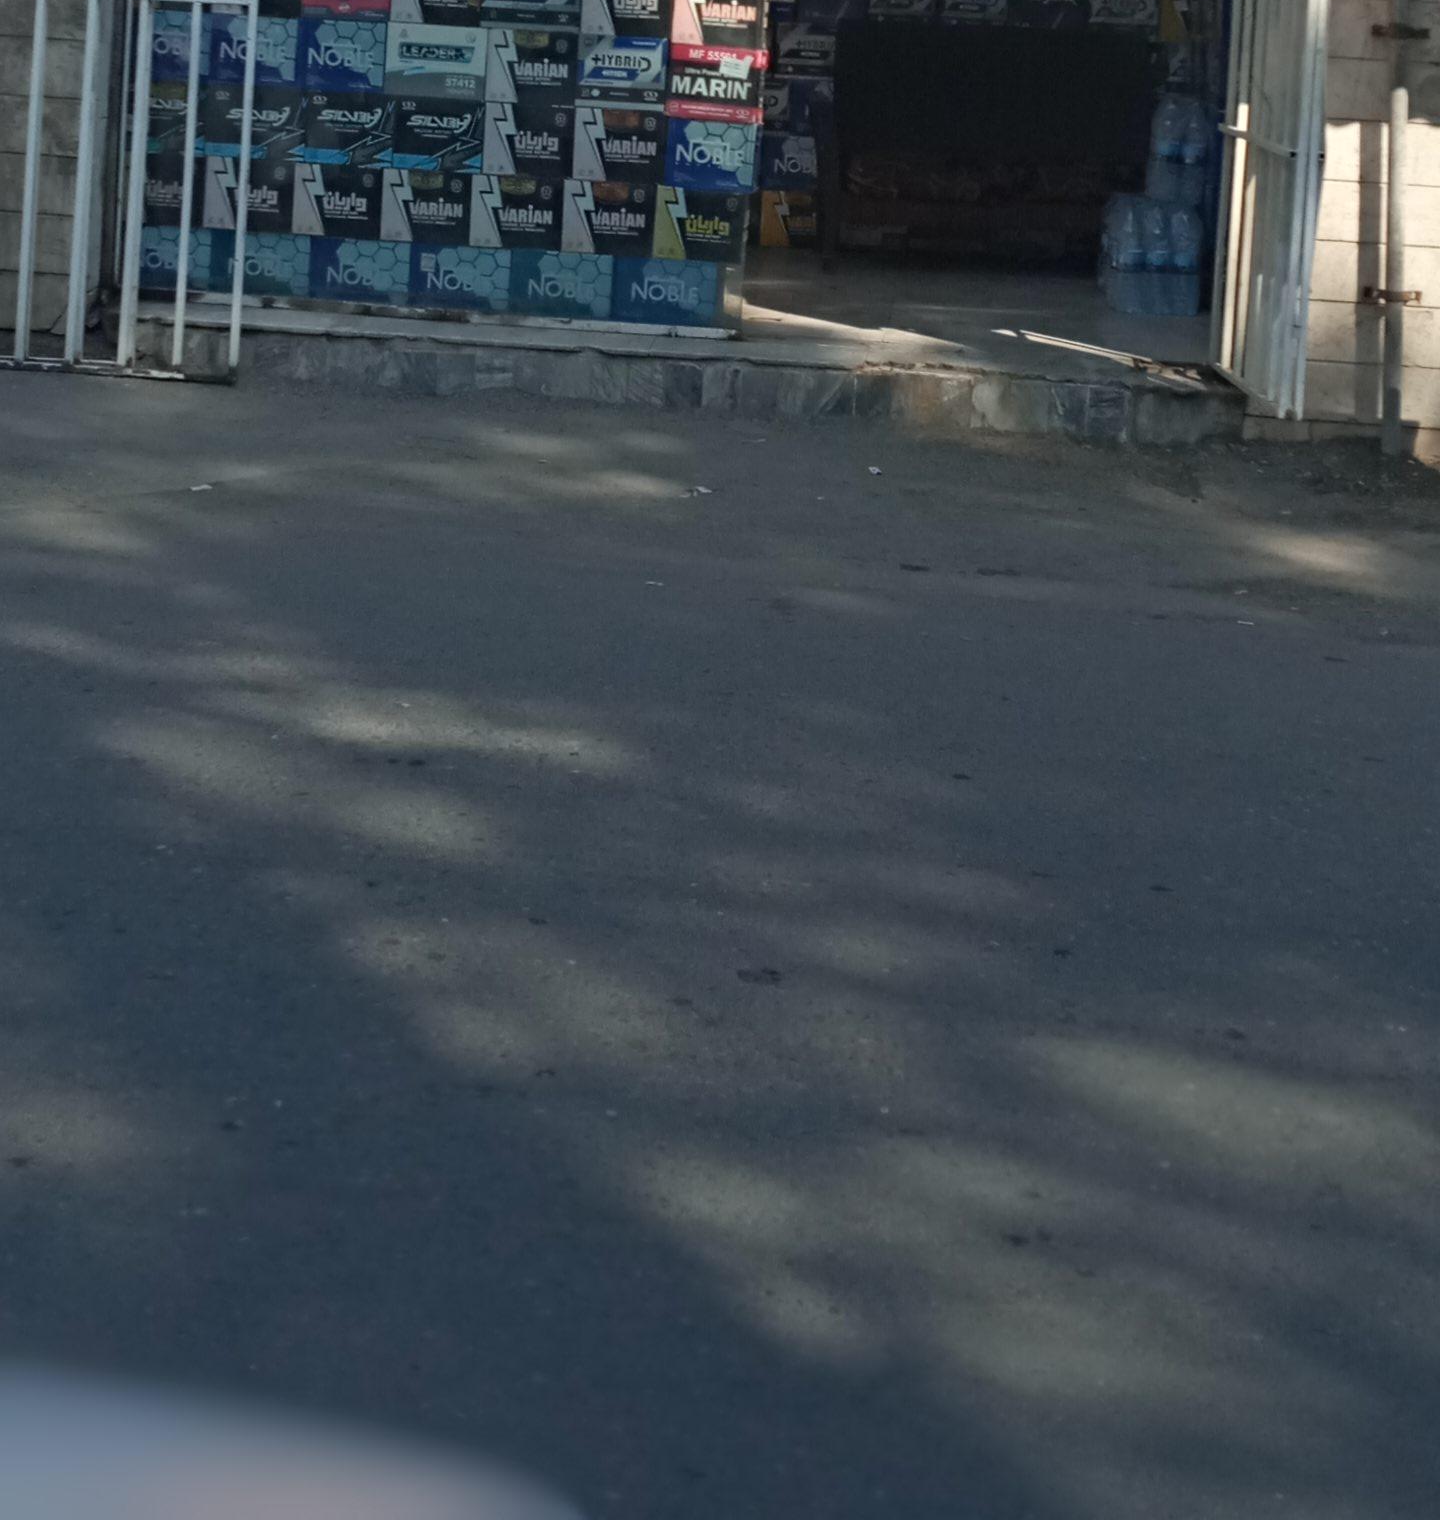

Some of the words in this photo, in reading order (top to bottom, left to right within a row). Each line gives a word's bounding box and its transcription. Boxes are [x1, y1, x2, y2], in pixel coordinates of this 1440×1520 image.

[700, 0, 758, 22] VARIAN
[307, 43, 375, 68] NOBLE
[688, 48, 705, 59] MF
[512, 58, 569, 79] VARIAN
[671, 75, 753, 101] MARIN
[514, 130, 560, 152] واریان
[601, 135, 658, 157] VARIAN
[674, 140, 745, 165] NOBLE
[322, 191, 368, 213] واریان
[409, 196, 464, 218] VARIAN
[498, 203, 554, 226] VARIAN
[590, 207, 647, 229] VARIAN
[685, 213, 731, 236] واریان
[630, 278, 700, 304] NOBLE
